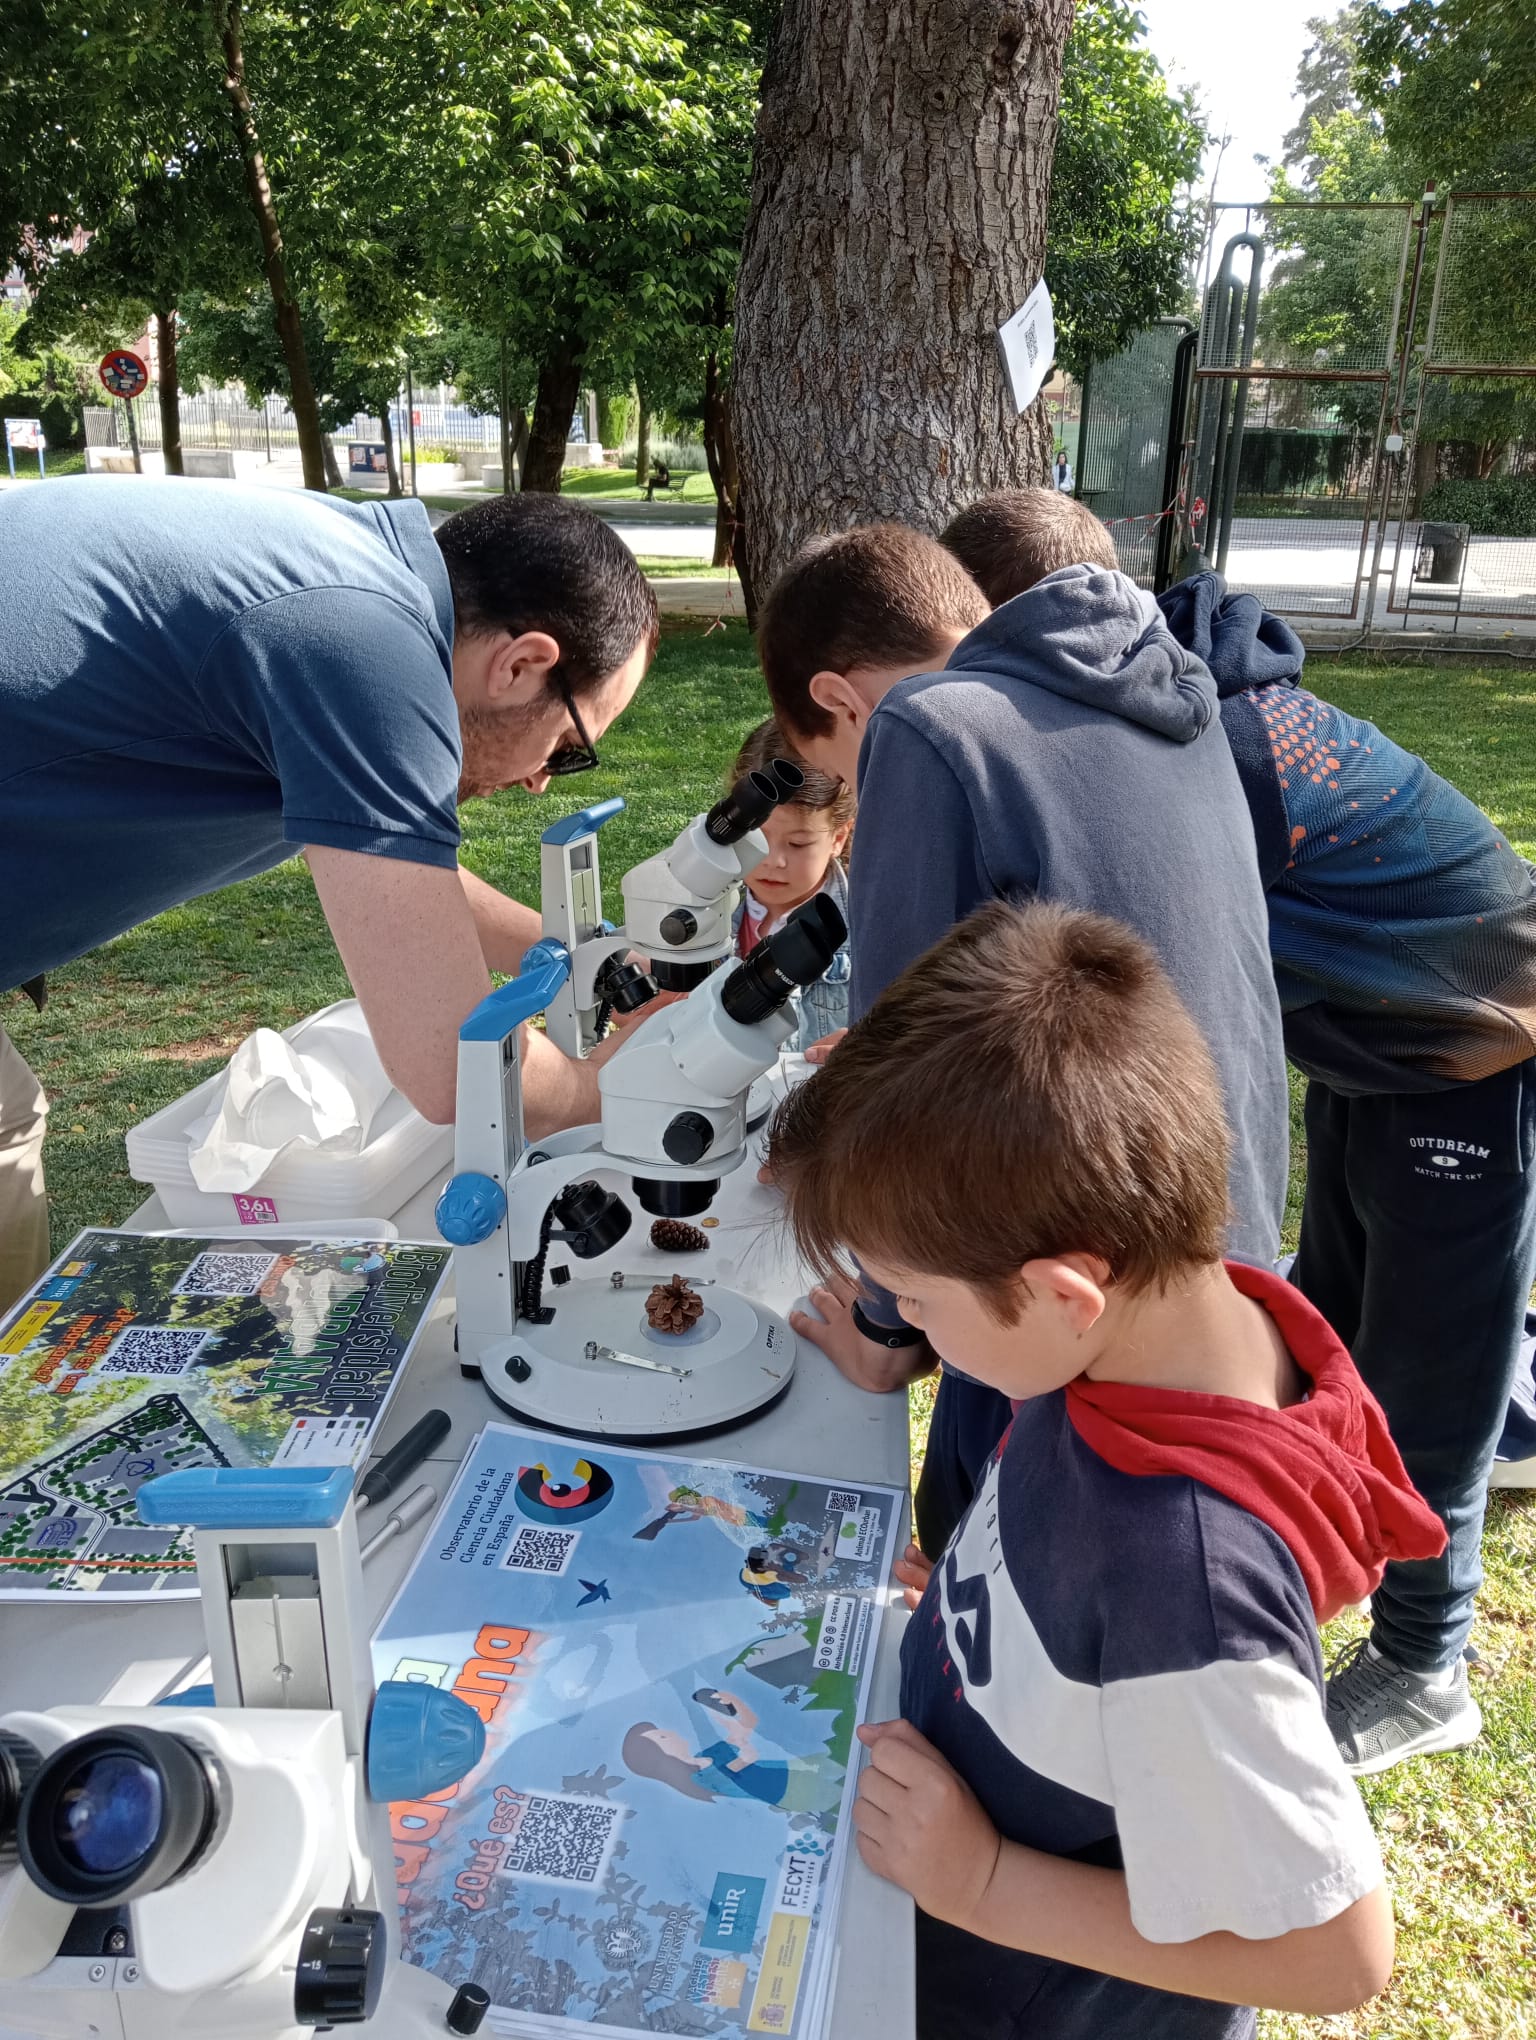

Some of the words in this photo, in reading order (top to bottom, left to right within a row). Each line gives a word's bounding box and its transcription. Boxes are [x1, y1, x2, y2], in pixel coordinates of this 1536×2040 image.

[239, 1198, 273, 1213] 3,6L
[322, 1250, 443, 1401] Biodiversidad
[474, 1479, 490, 1493] de
[480, 1467, 497, 1478] la
[440, 1493, 483, 1561] Observatorio
[460, 1526, 488, 1563] Ciencia
[480, 1471, 515, 1524] Ciudadana
[487, 1513, 515, 1551] España
[482, 1553, 496, 1567] en
[453, 1838, 505, 1911] ¿Qué
[488, 1784, 526, 1835] es?
[781, 1855, 807, 1908] FECYT
[651, 1911, 679, 1991] UNIVERSIDAD
